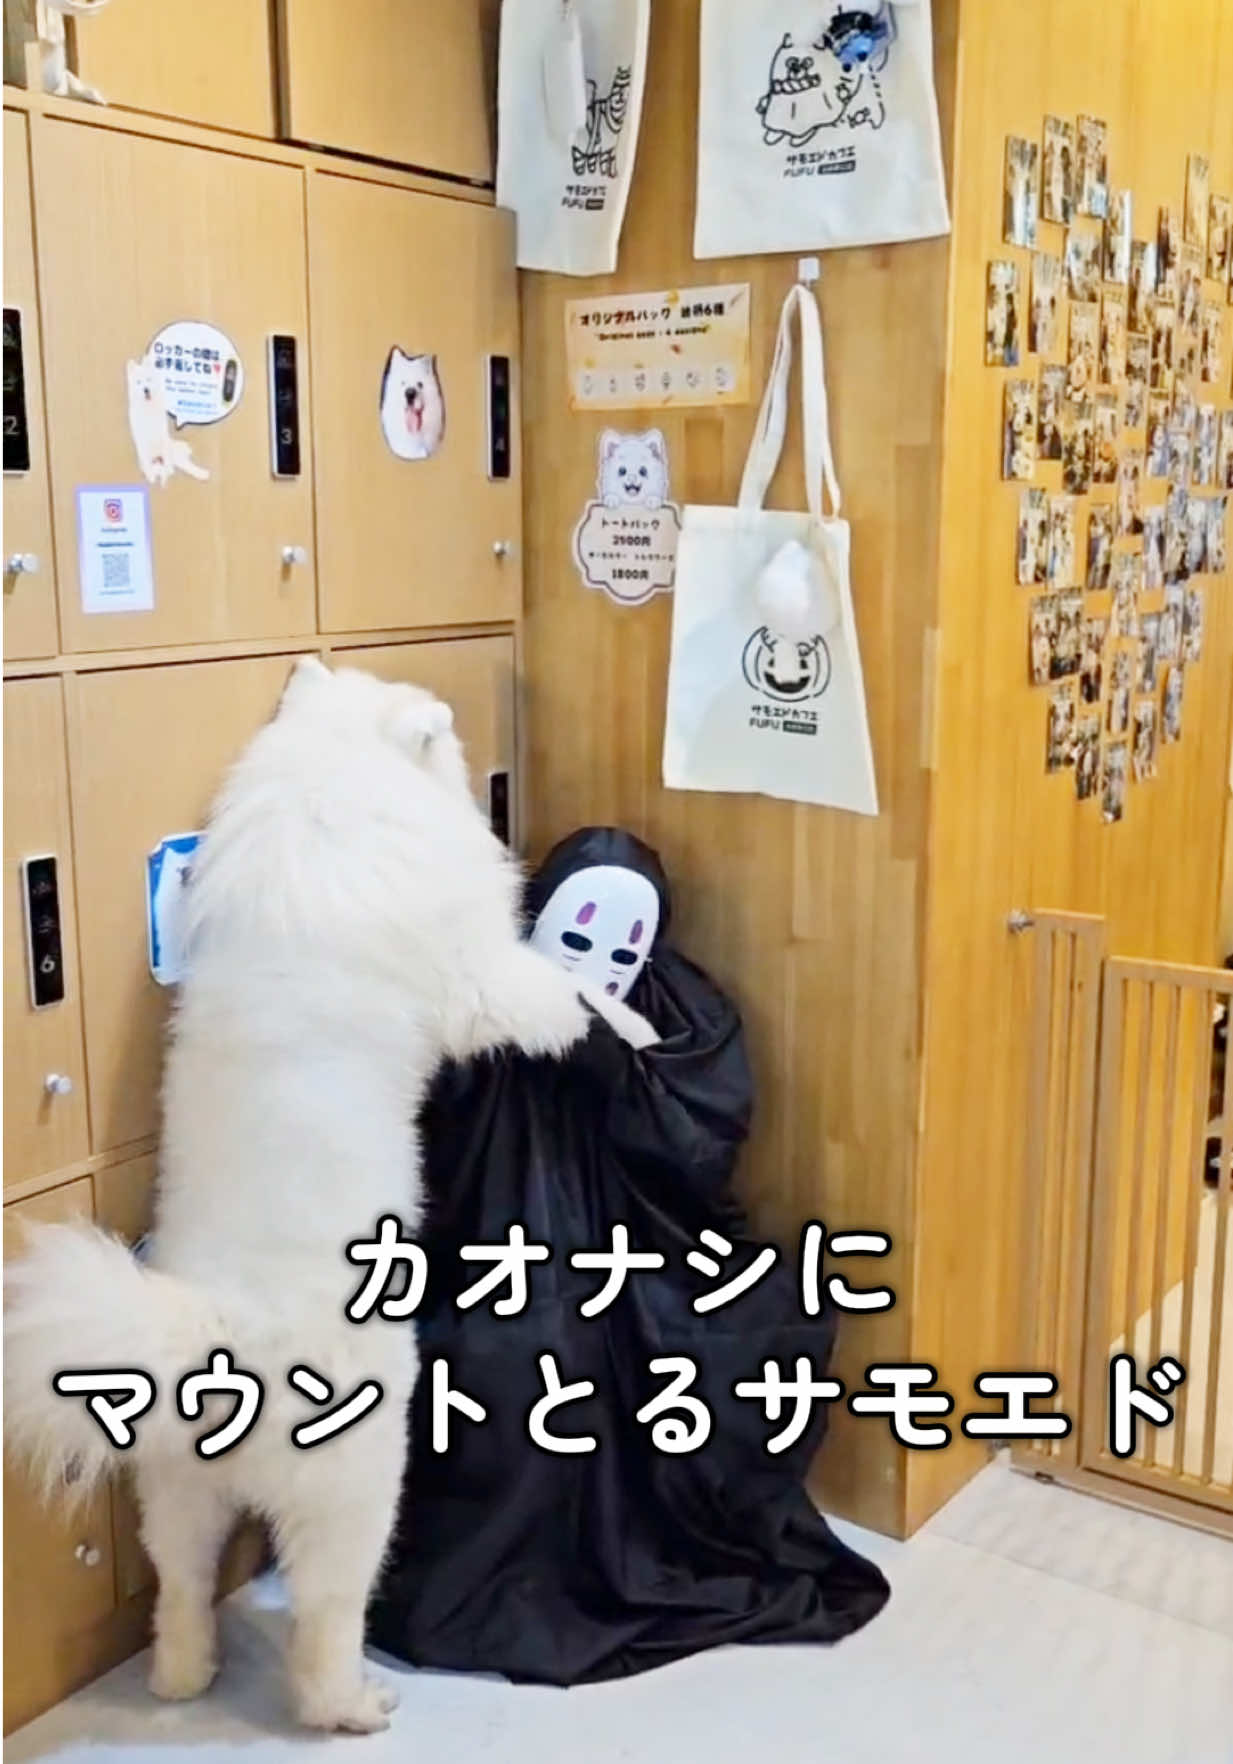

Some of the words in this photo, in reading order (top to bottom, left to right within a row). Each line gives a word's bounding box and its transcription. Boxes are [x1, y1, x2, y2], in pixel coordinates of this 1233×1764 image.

[5, 415, 19, 435] 2
[281, 428, 292, 445] 3
[40, 955, 55, 973] 6
